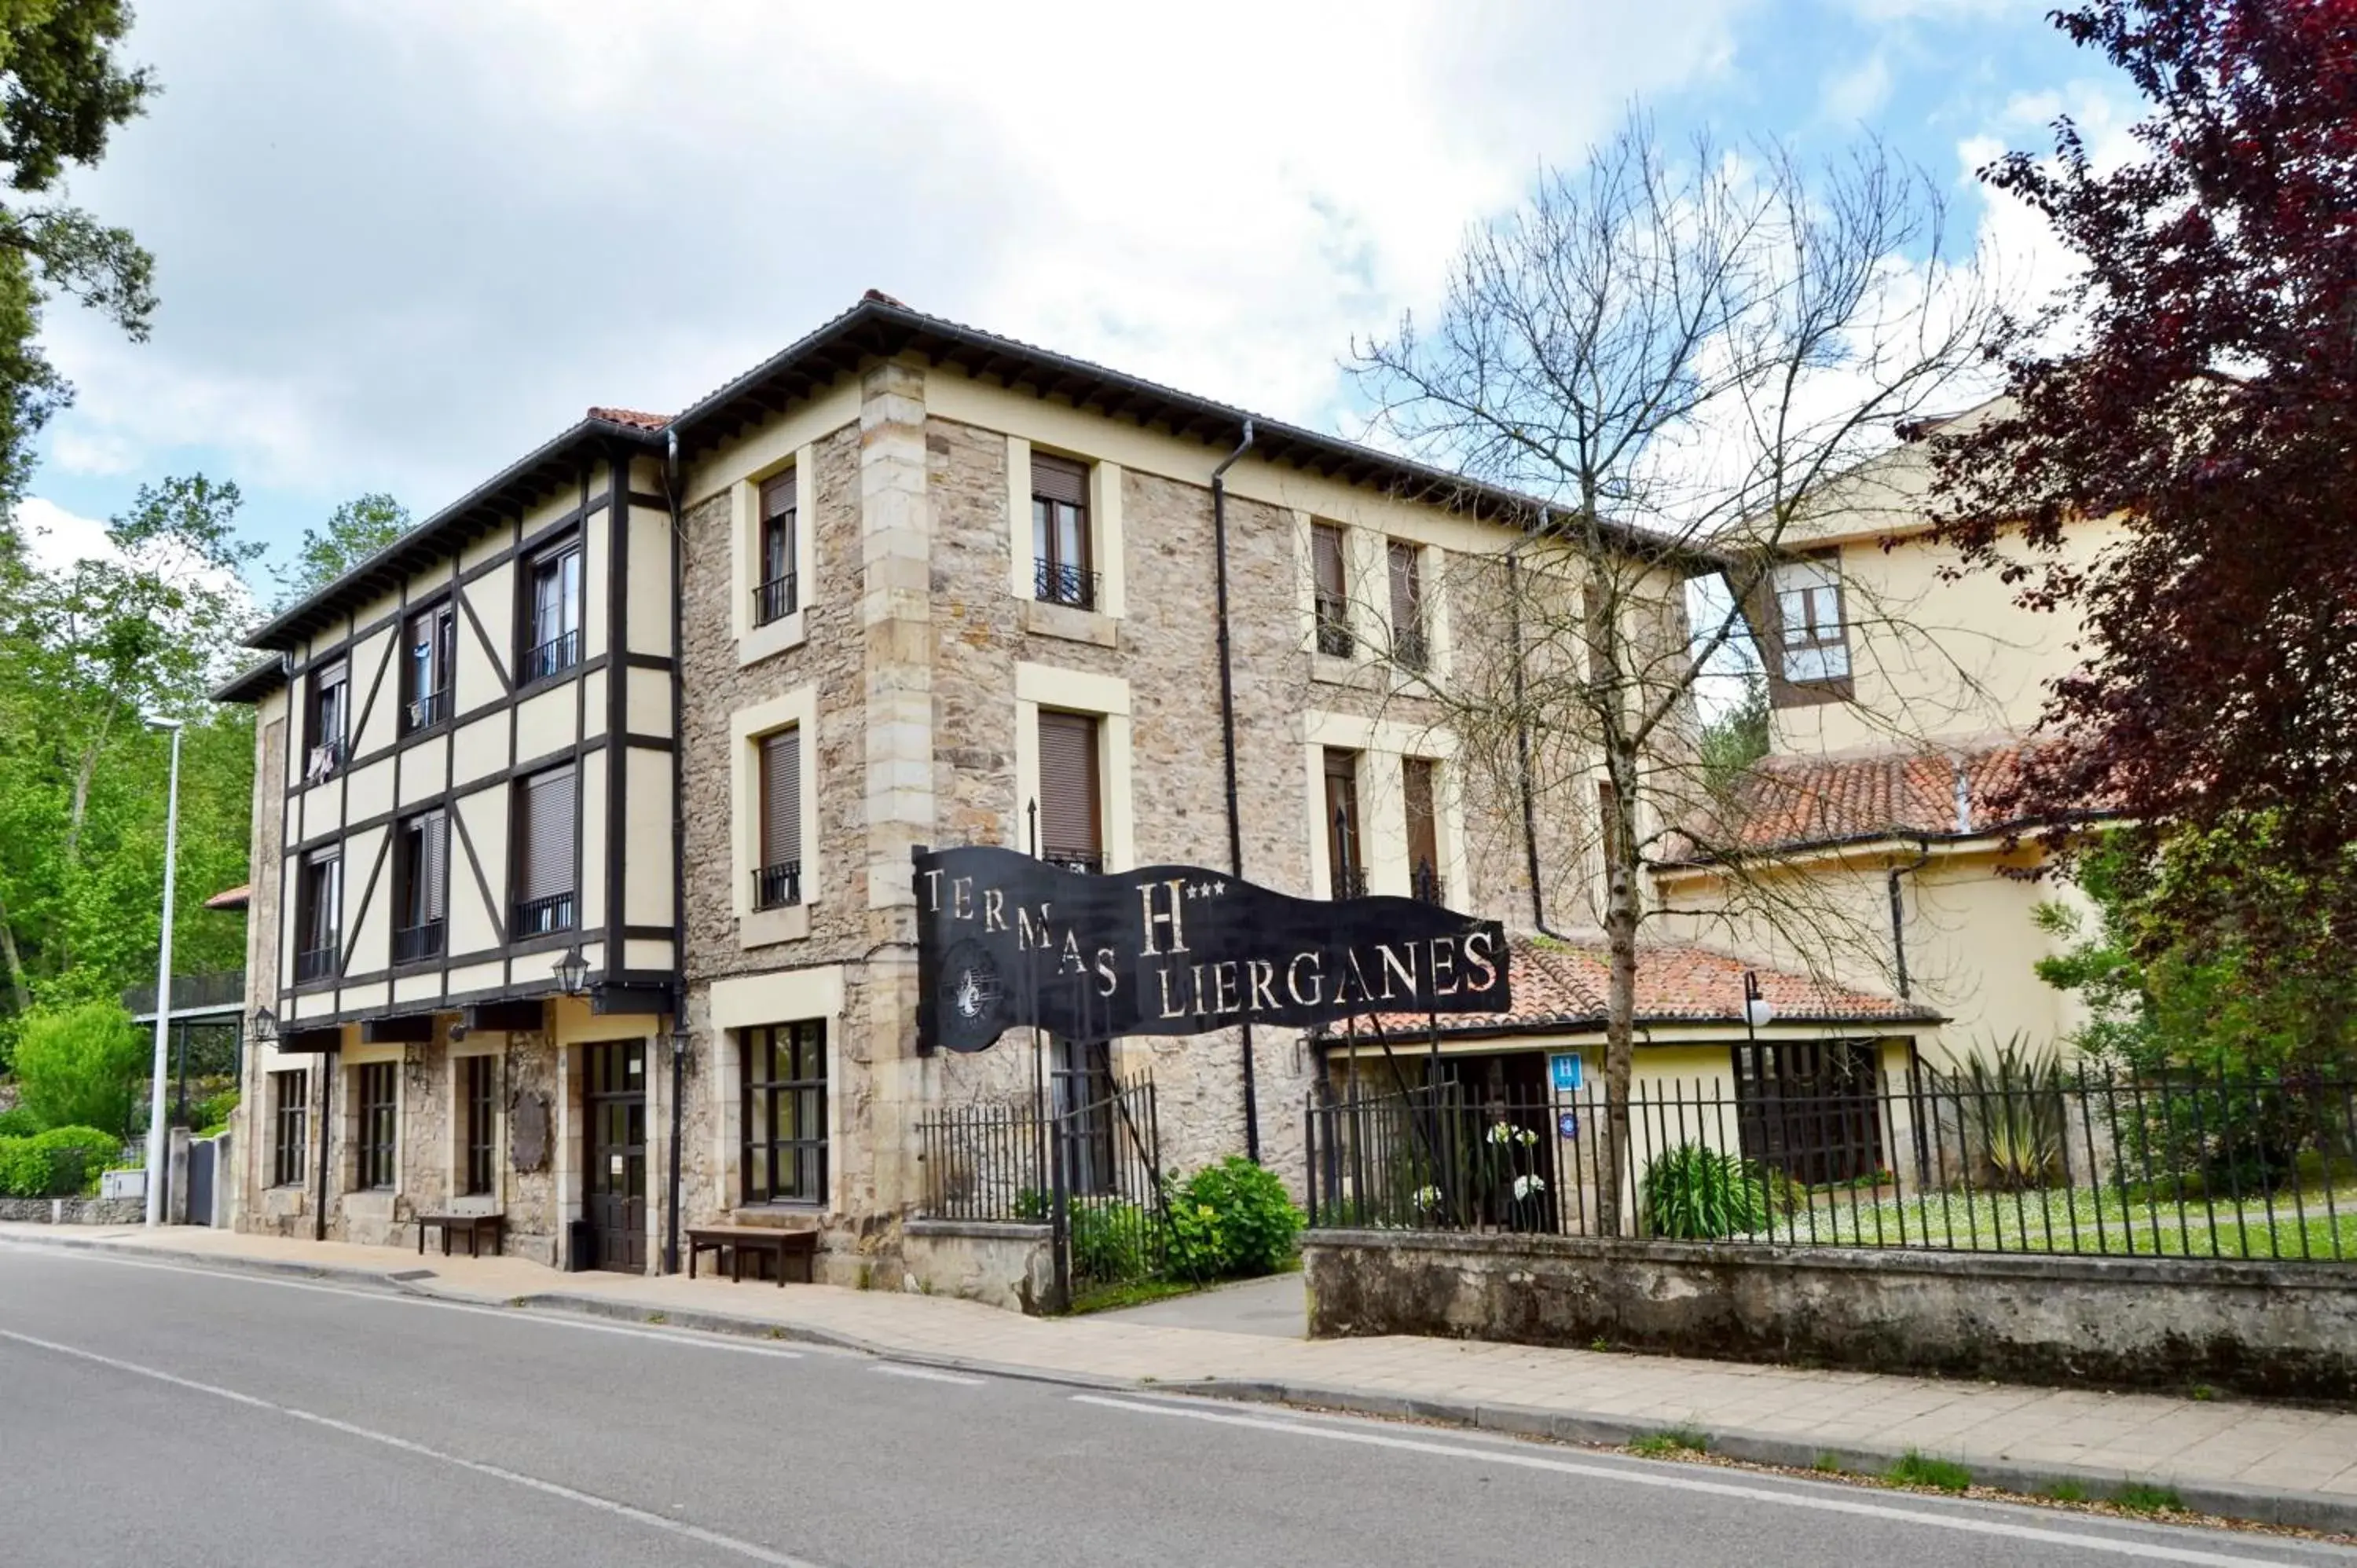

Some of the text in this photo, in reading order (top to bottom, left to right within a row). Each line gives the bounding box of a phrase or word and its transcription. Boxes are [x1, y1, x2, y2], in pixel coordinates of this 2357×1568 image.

[924, 868, 1117, 998] TERMAS
[1156, 931, 1497, 1019] LIERGANES
[1559, 1058, 1573, 1077] H
